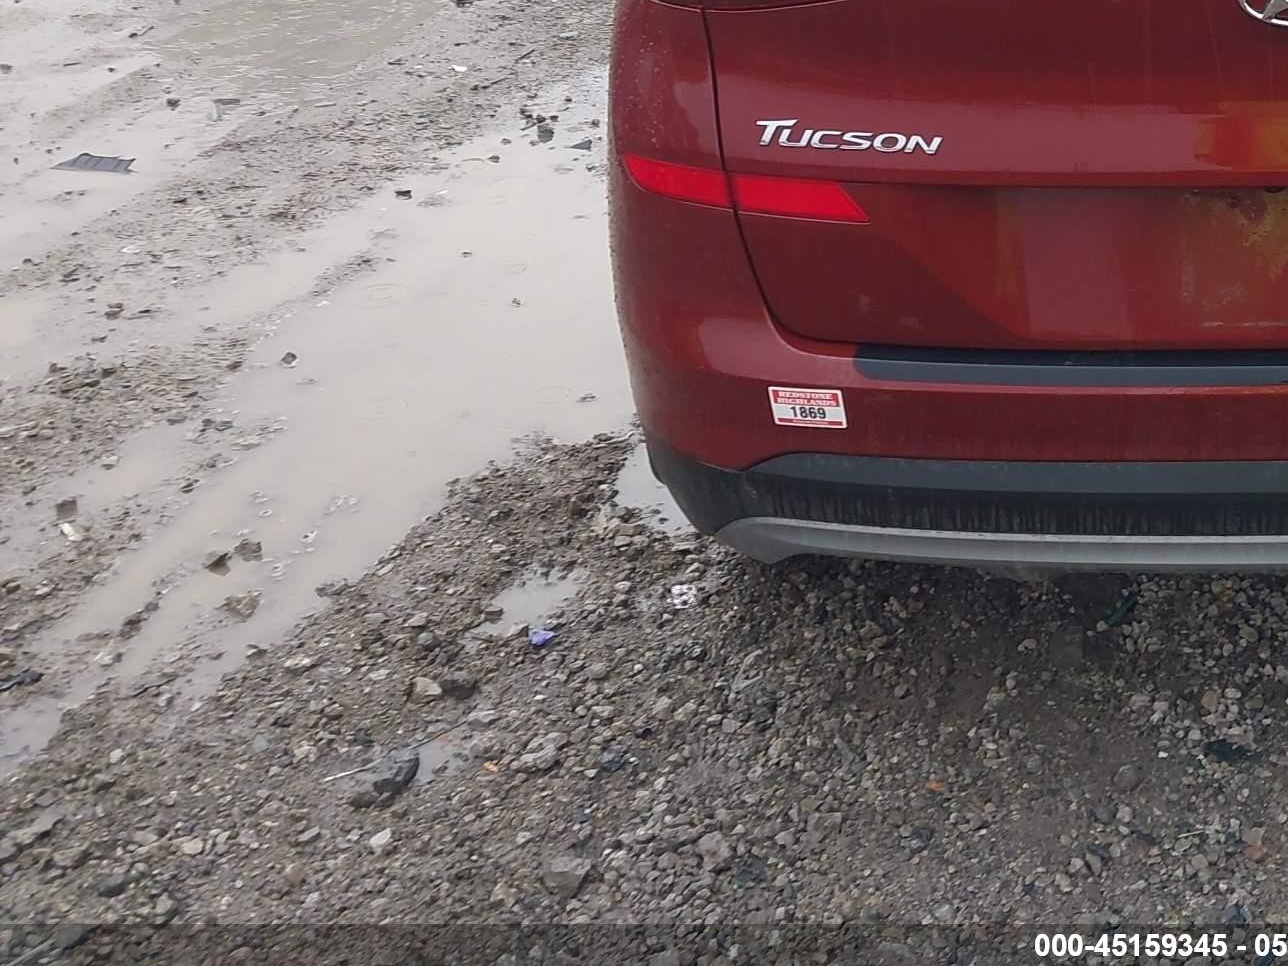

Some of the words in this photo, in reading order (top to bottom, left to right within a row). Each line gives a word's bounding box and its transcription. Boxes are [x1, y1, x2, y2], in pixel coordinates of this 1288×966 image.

[755, 119, 943, 155] TUCSON
[778, 391, 833, 400] REDSTONE
[777, 397, 838, 407] HIGHLANDS
[790, 406, 827, 419] 1869
